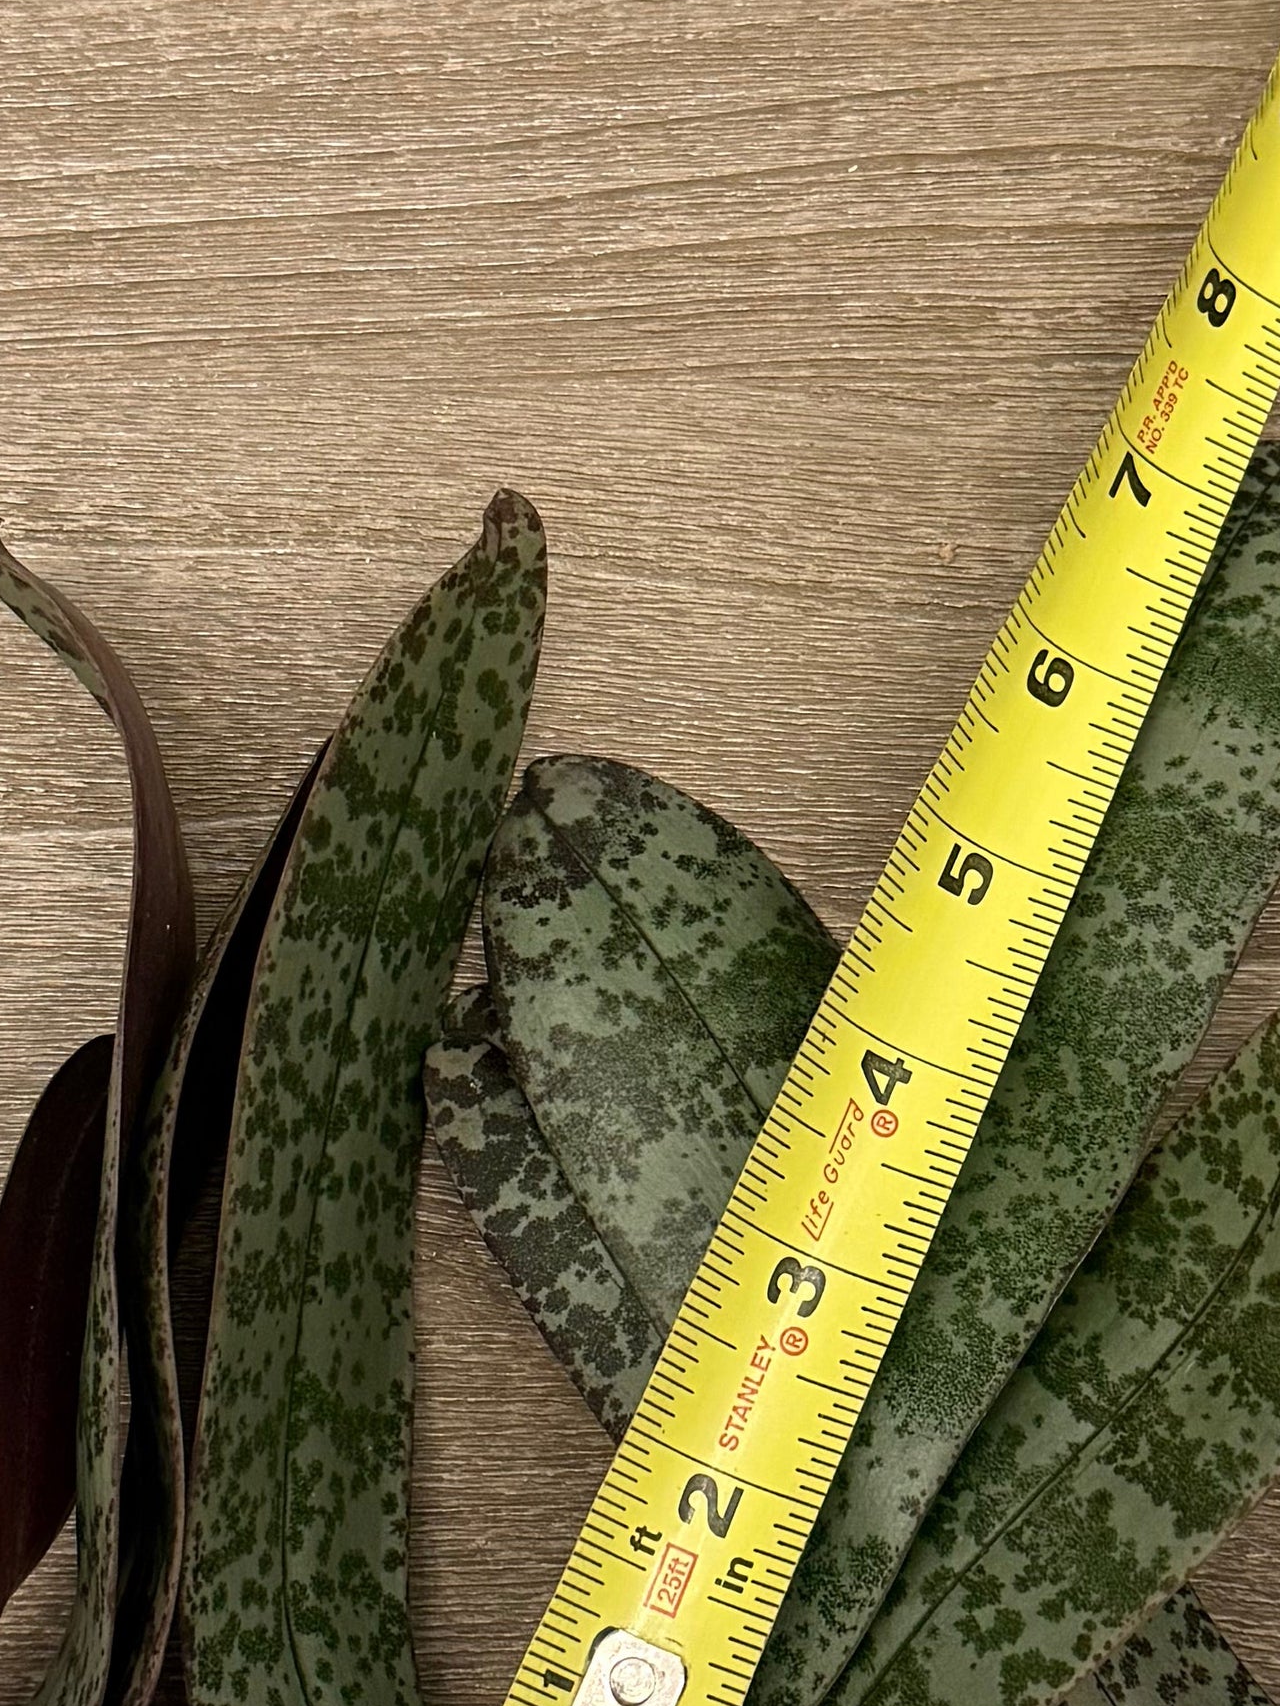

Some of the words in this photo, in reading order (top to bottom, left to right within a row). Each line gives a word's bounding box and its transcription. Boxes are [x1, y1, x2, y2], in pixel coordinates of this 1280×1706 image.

[1196, 267, 1237, 328] 8
[1136, 414, 1157, 444] P.R.
[1152, 359, 1178, 411] APP'D
[1145, 426, 1165, 455] NO.
[1160, 392, 1178, 423] 339
[1172, 367, 1189, 390] TC
[1108, 452, 1152, 508] 7
[1026, 648, 1075, 708] 6
[937, 842, 994, 906] 5
[860, 1049, 913, 1106] 4
[766, 1255, 827, 1319] 3
[718, 1333, 777, 1452] STANLEY
[677, 1472, 745, 1539] 2
[629, 1525, 663, 1556] ft
[657, 1556, 690, 1607] 25ft
[714, 1556, 755, 1594] in
[542, 1668, 575, 1693] 1
